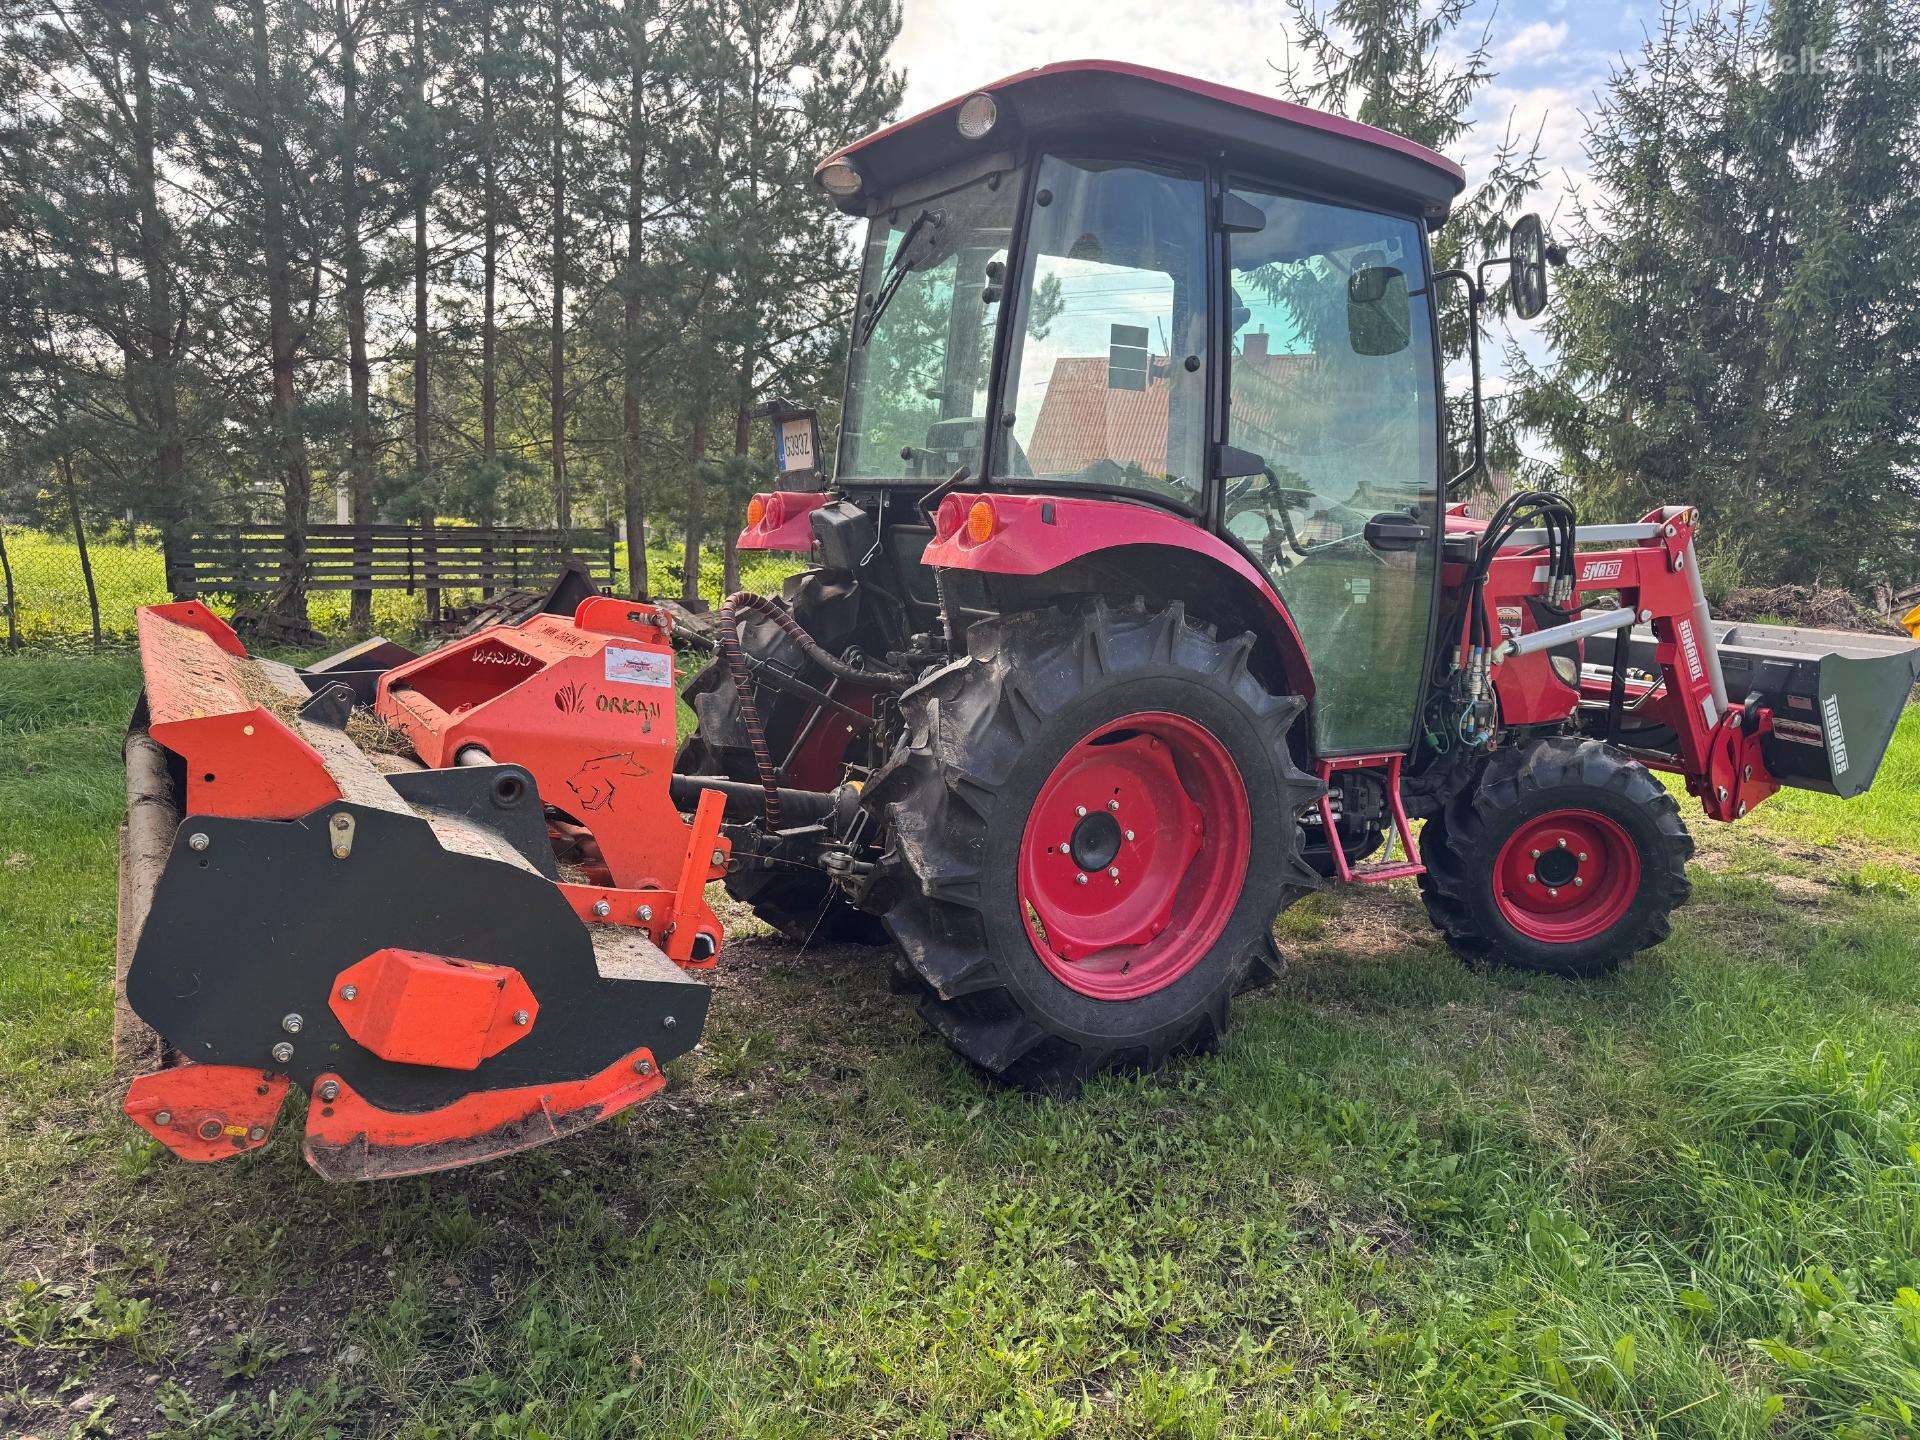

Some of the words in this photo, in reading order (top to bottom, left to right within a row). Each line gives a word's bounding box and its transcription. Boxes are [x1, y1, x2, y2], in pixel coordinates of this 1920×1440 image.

[1679, 620, 1702, 681] SONAROL
[595, 694, 661, 720] ORKAN
[1824, 695, 1848, 775] SONAROL
